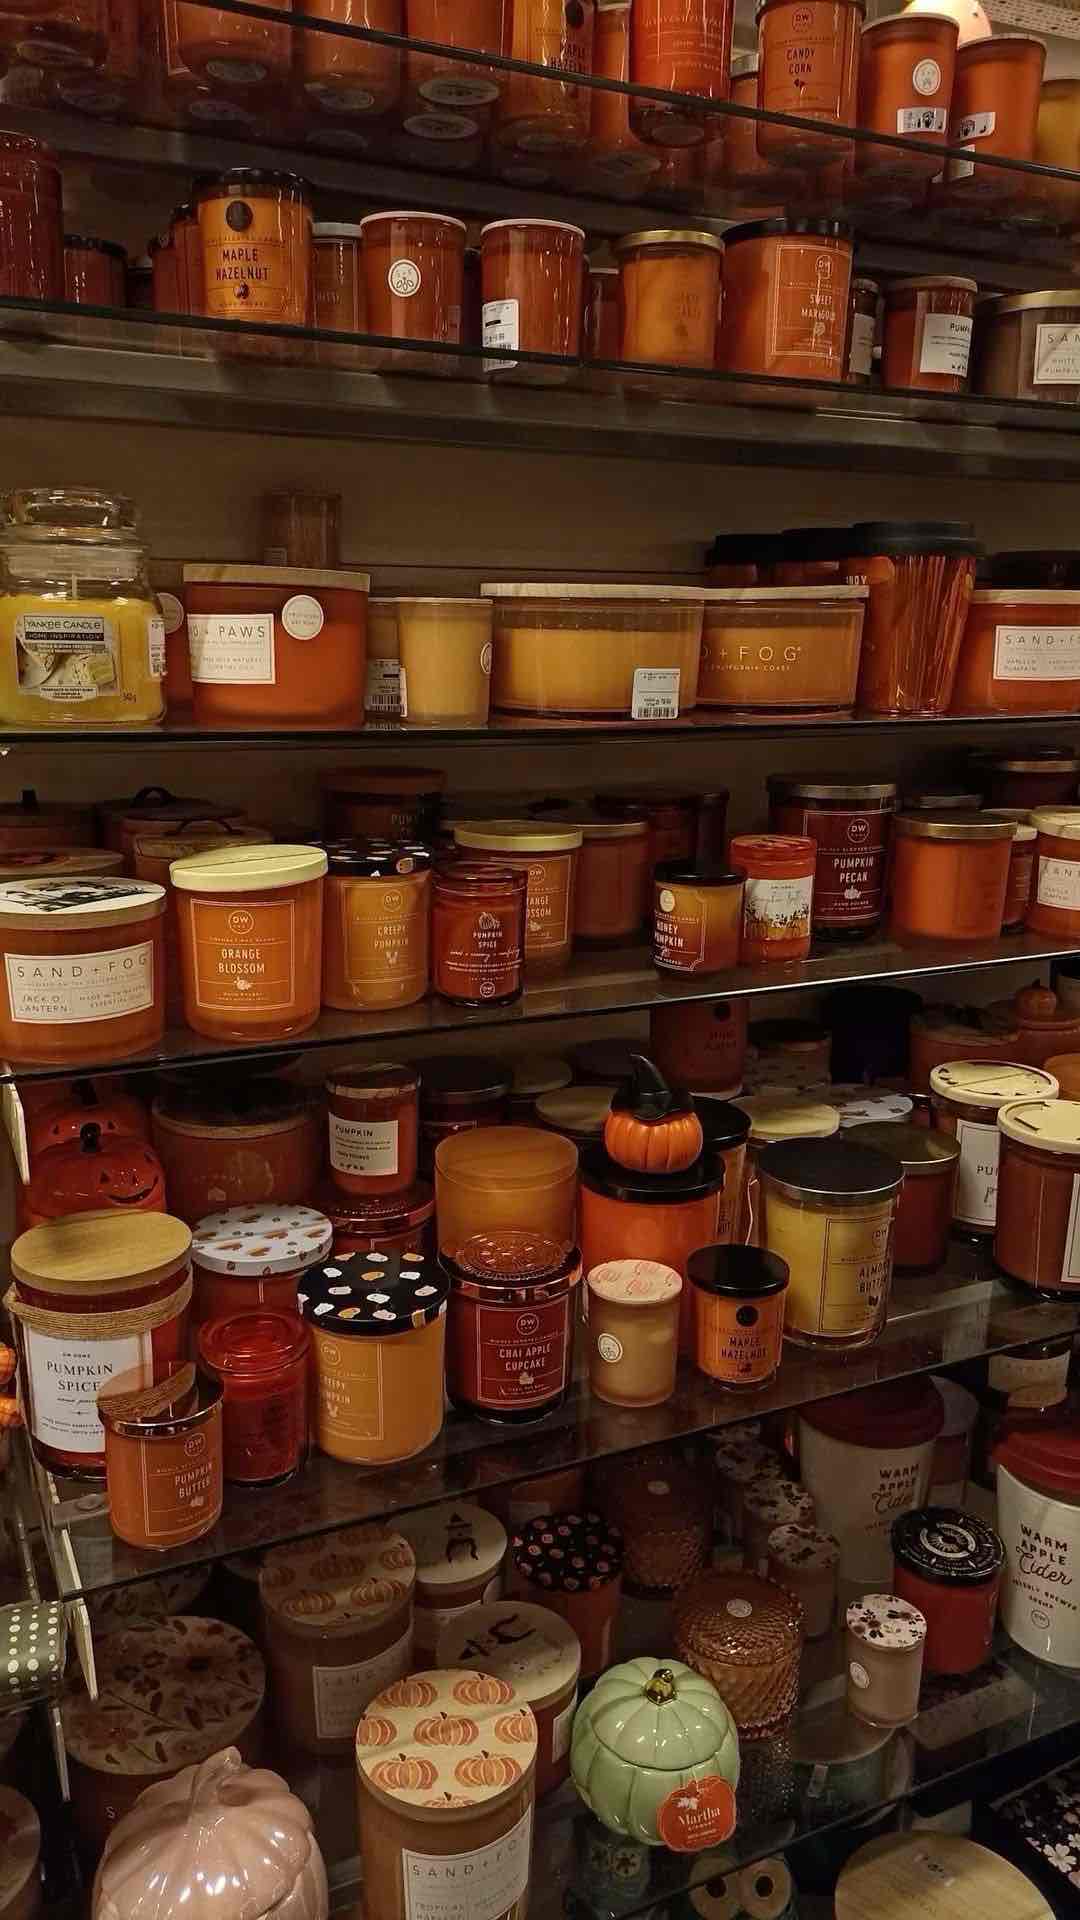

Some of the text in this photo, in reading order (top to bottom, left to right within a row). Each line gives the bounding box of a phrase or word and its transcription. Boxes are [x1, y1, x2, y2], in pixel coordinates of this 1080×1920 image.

[786, 47, 816, 61] CANDY
[788, 61, 813, 75] CORN
[222, 247, 259, 263] MAPLE
[215, 266, 271, 281] HAZELNUT
[26, 619, 102, 630] YANKEE CANDLE
[218, 625, 266, 639] PAWS
[1005, 634, 1055, 645] SAND
[833, 856, 874, 869] PUMPKIN
[839, 871, 868, 884] PECAN
[473, 930, 504, 939] PUMPKIN
[221, 948, 263, 961] ORANGE
[16, 965, 83, 978] SAND
[108, 952, 149, 973] FOG
[217, 962, 266, 975] BLOSSOM
[18, 1003, 70, 1013] LANTERN
[335, 1124, 374, 1137] PUMPKIN
[728, 1335, 762, 1348] MAPLE
[499, 1342, 551, 1359] CHAI APPLE
[720, 1348, 767, 1360] HAZELNUT
[46, 1359, 114, 1377] PUMPKIN
[504, 1357, 545, 1372] CUPCAKE
[57, 1380, 102, 1393] SPICE
[174, 1462, 213, 1486] PUMPKIN
[878, 1463, 921, 1479] WARM
[178, 1478, 210, 1499] BUTTER
[1020, 1523, 1068, 1552] WARM
[1020, 1536, 1067, 1566] APPLE
[1015, 1545, 1073, 1586] Cider
[677, 1807, 721, 1826] Martha
[412, 1863, 475, 1878] SAND
